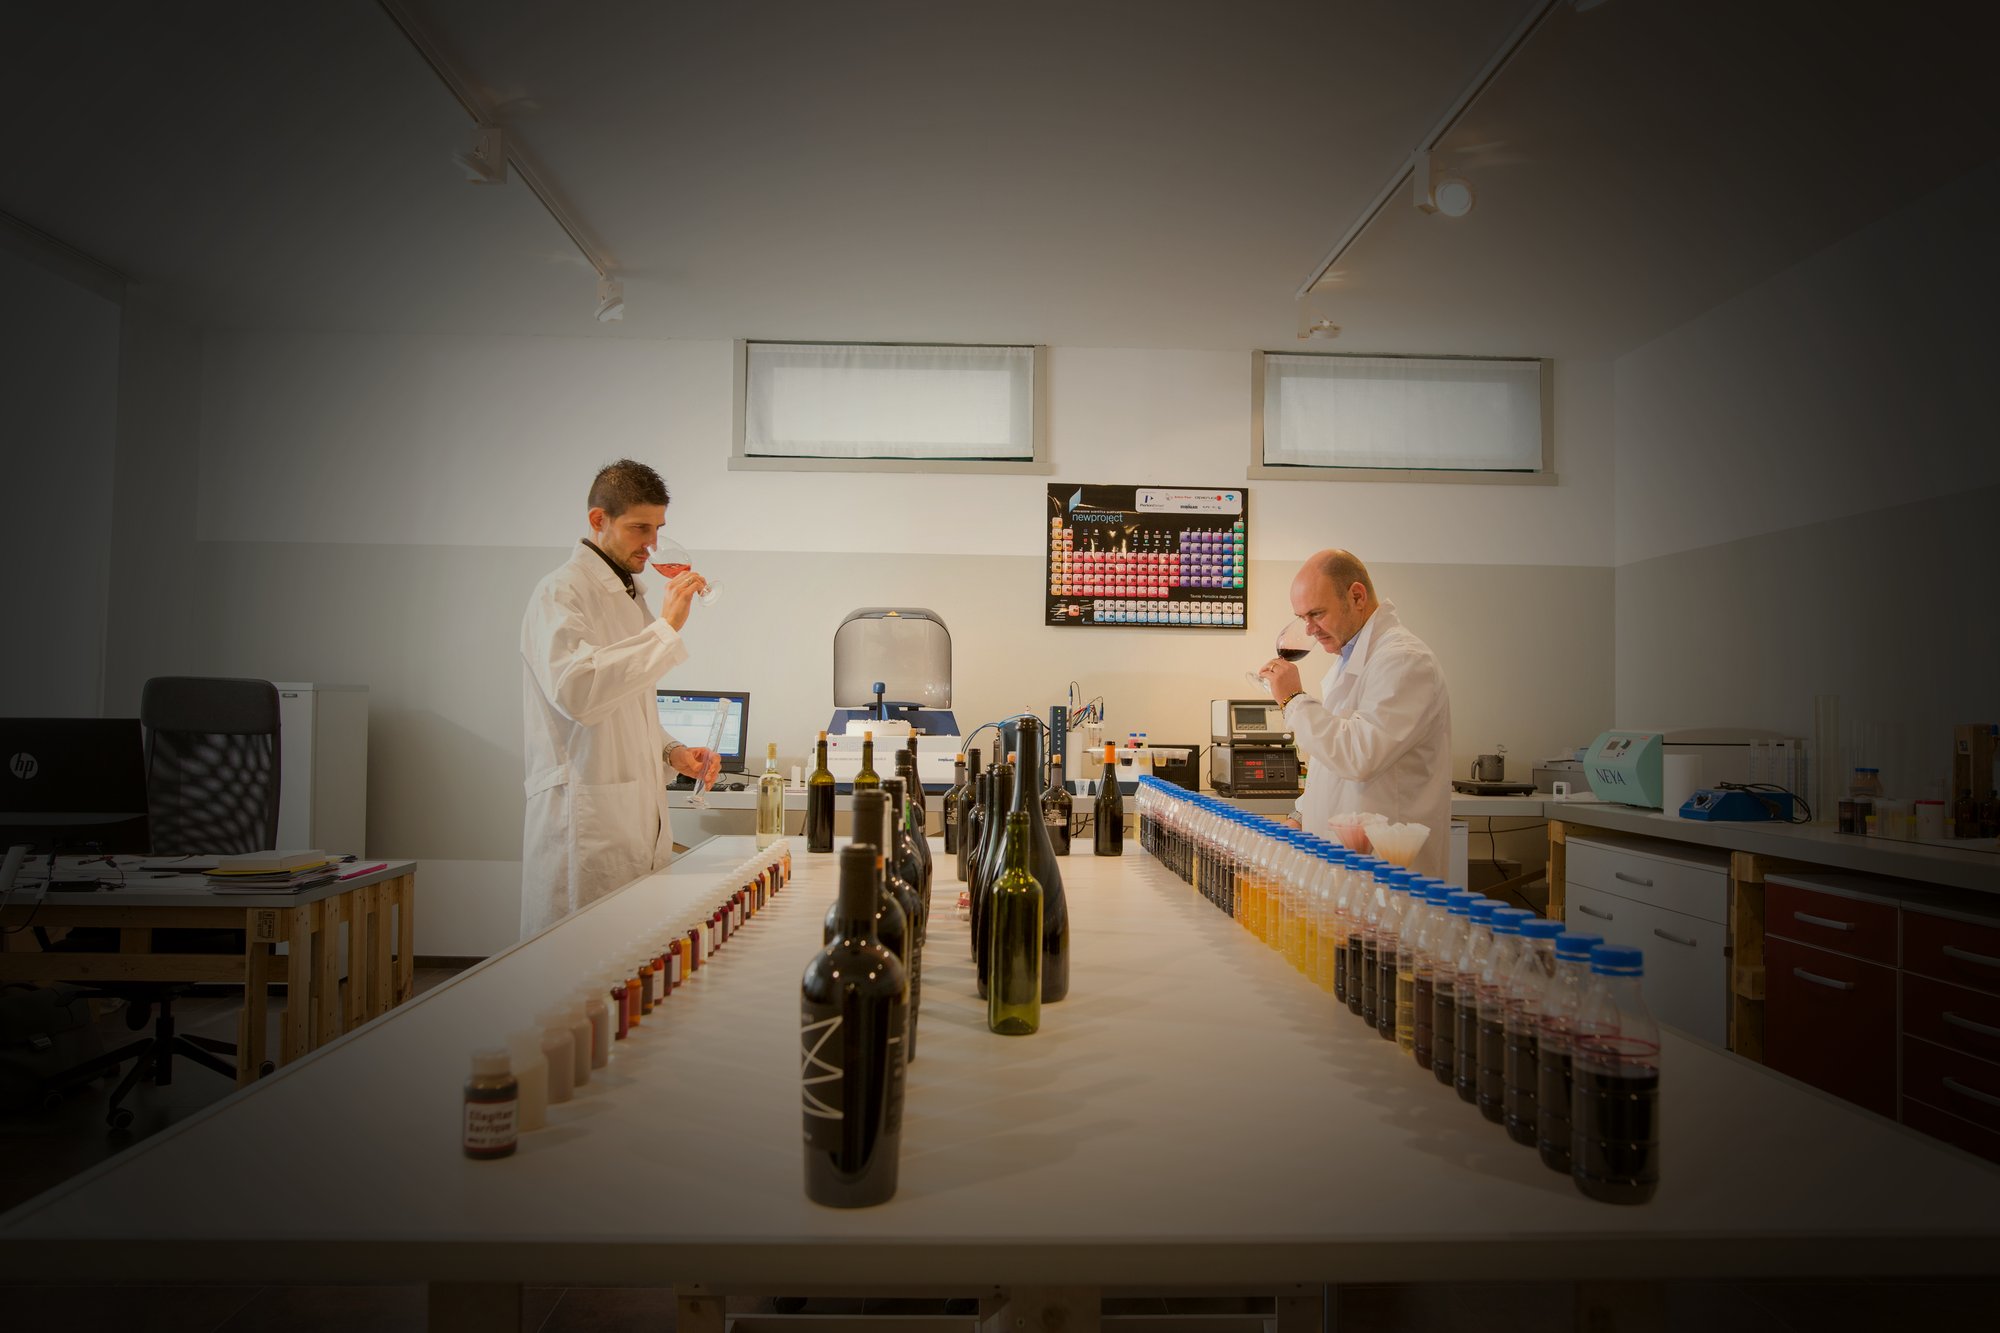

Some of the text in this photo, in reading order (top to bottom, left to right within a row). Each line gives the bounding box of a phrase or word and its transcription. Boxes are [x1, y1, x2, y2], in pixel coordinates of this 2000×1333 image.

[1072, 513, 1124, 525] newproject
[14, 752, 35, 780] hp
[1596, 768, 1627, 785] NEYA
